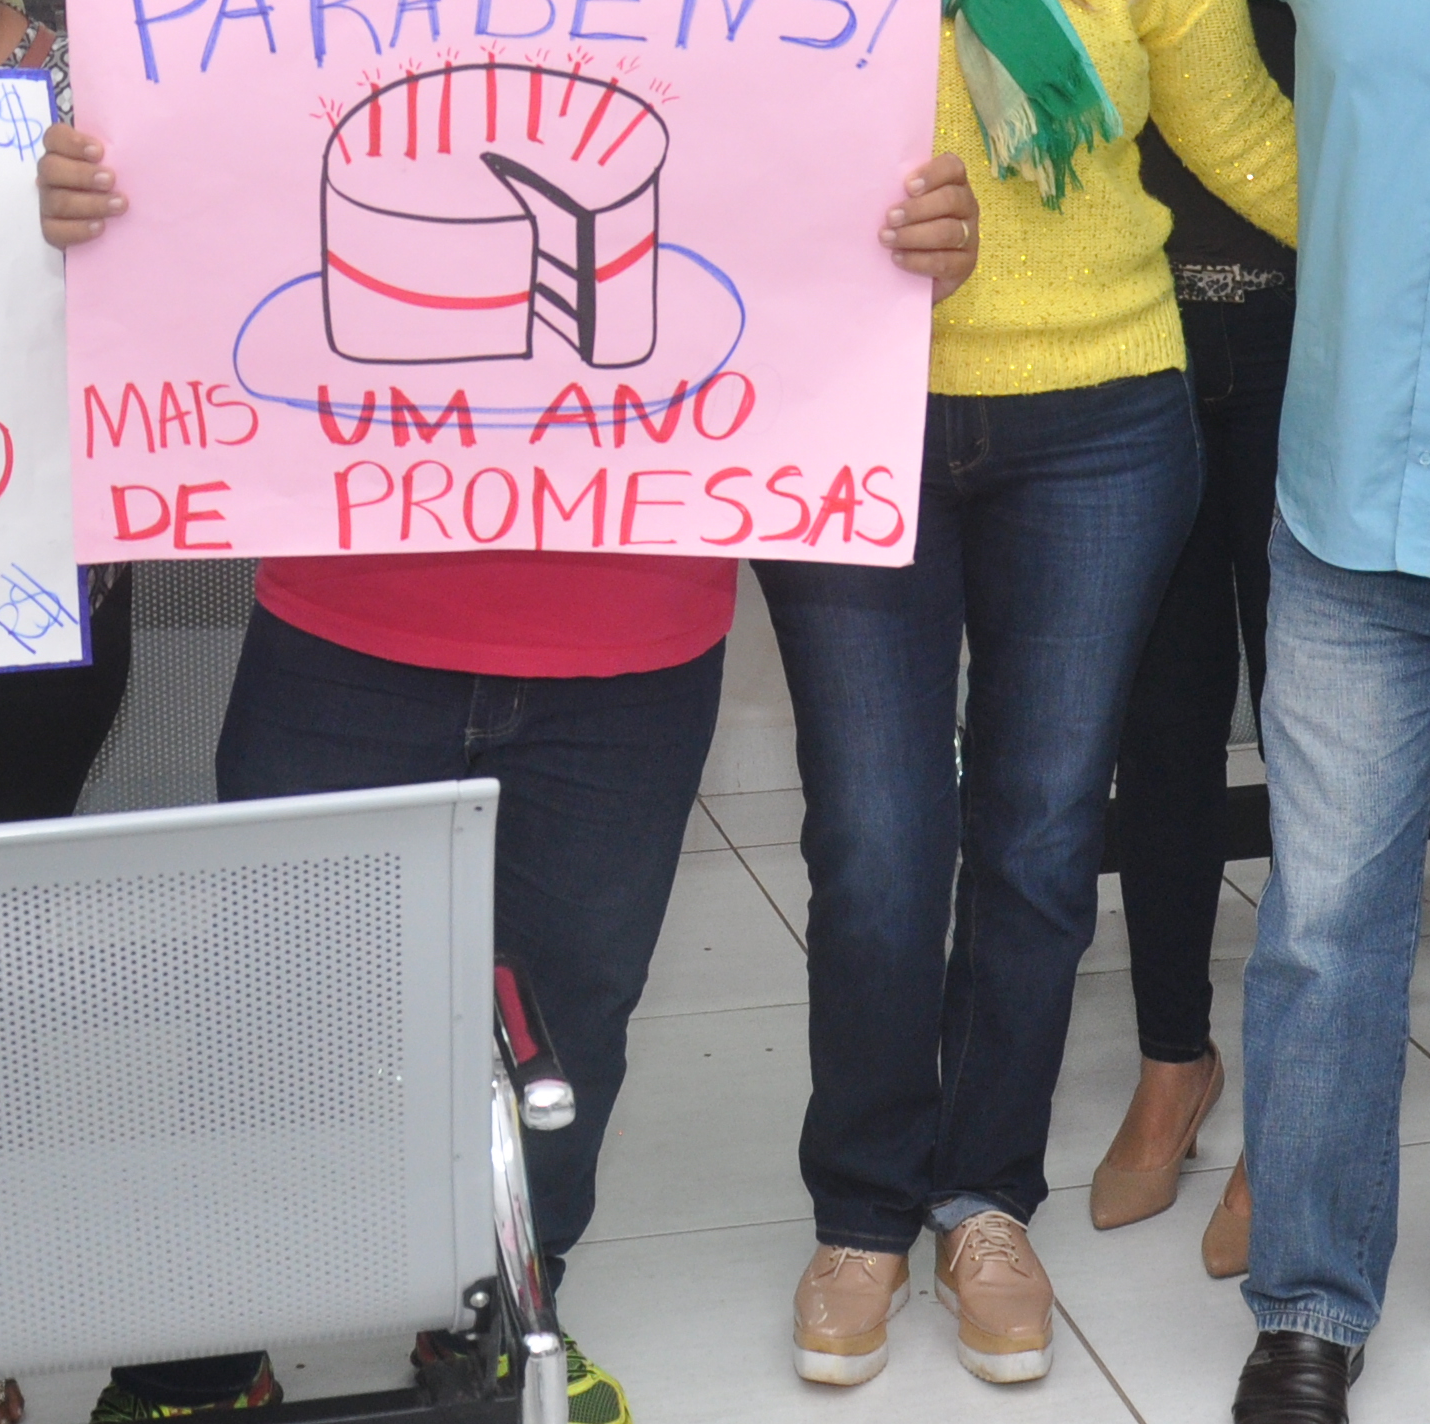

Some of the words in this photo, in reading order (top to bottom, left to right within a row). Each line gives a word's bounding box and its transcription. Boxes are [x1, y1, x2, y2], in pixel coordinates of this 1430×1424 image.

[83, 381, 258, 459] MAIS
[318, 385, 476, 446] UM
[530, 371, 756, 445] ANO
[112, 481, 233, 549] DE
[335, 460, 905, 549] PROMESSAS
